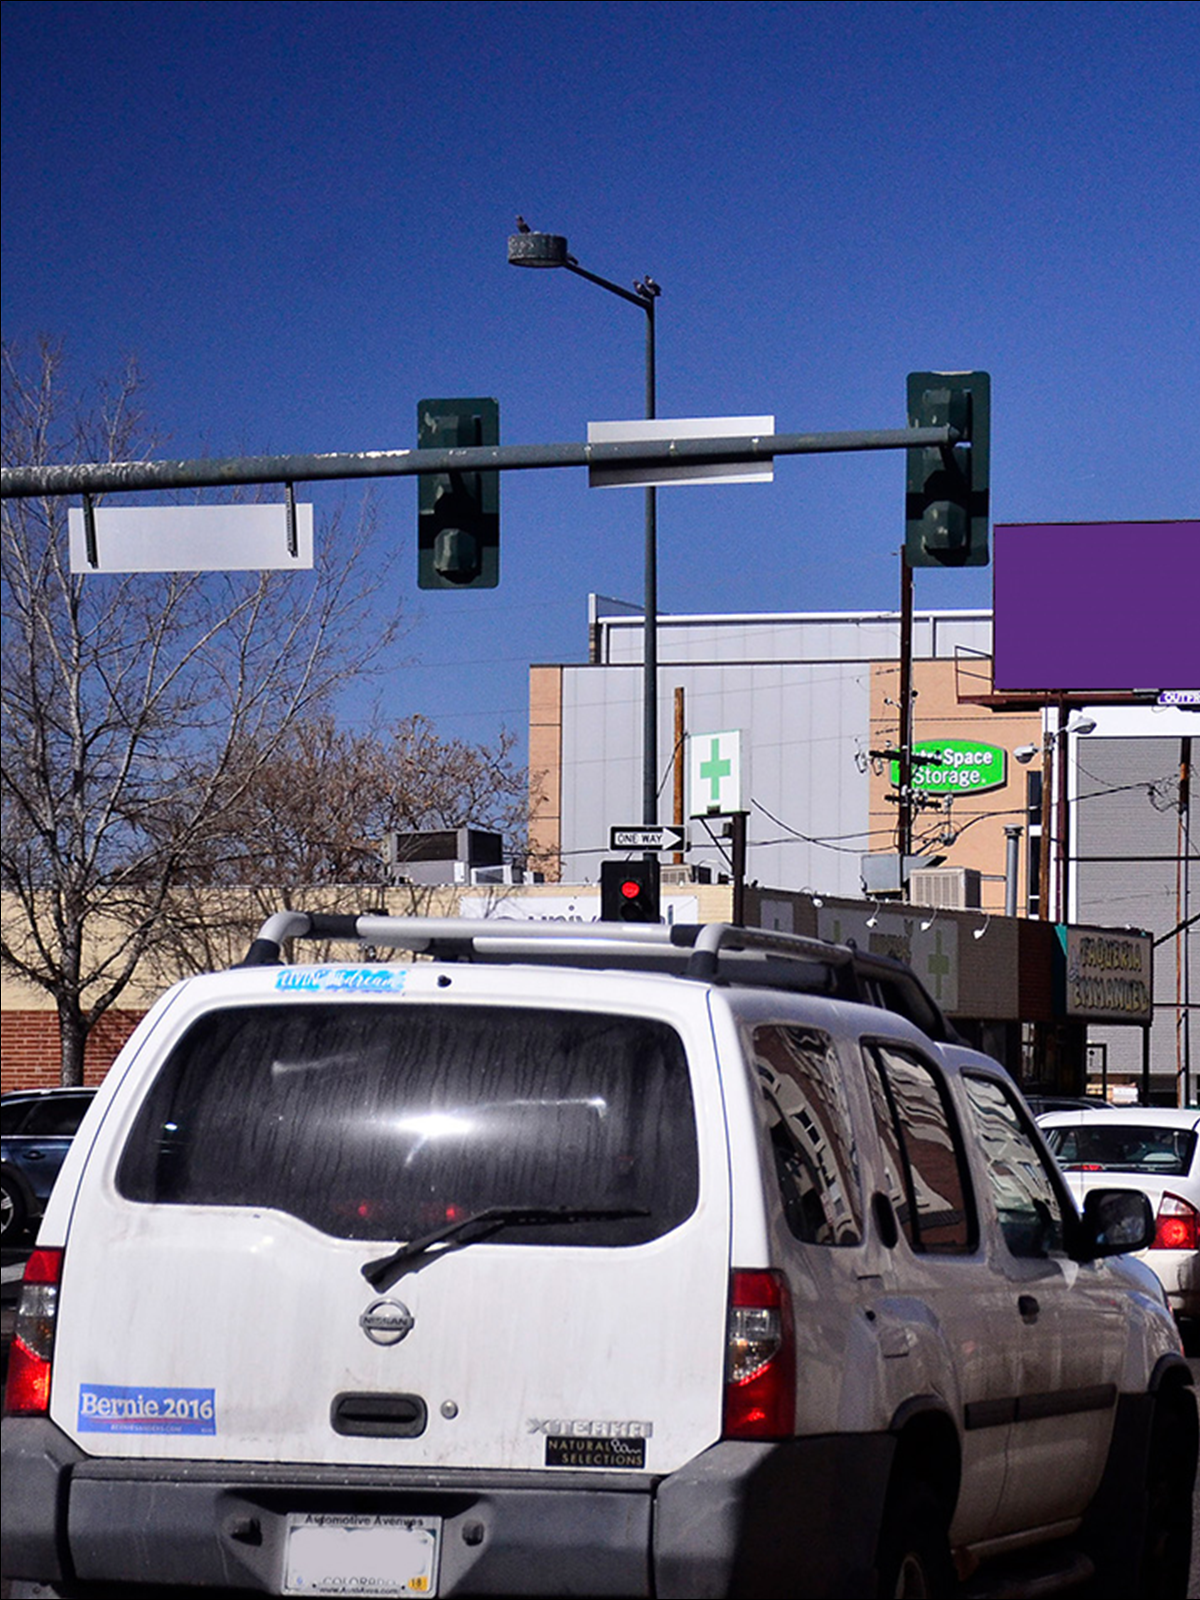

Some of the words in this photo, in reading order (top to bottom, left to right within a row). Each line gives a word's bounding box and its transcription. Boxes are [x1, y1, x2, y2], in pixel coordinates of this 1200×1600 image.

[617, 834, 638, 844] ONE
[641, 834, 662, 844] WAY
[363, 1316, 410, 1326] NISSAN
[81, 1392, 159, 1416] Bernie
[163, 1398, 213, 1420] 2016
[548, 1440, 611, 1451] NATURAL
[562, 1454, 643, 1466] SELECTIONS
[305, 1515, 371, 1526] Automotive
[374, 1516, 424, 1526] Avenues
